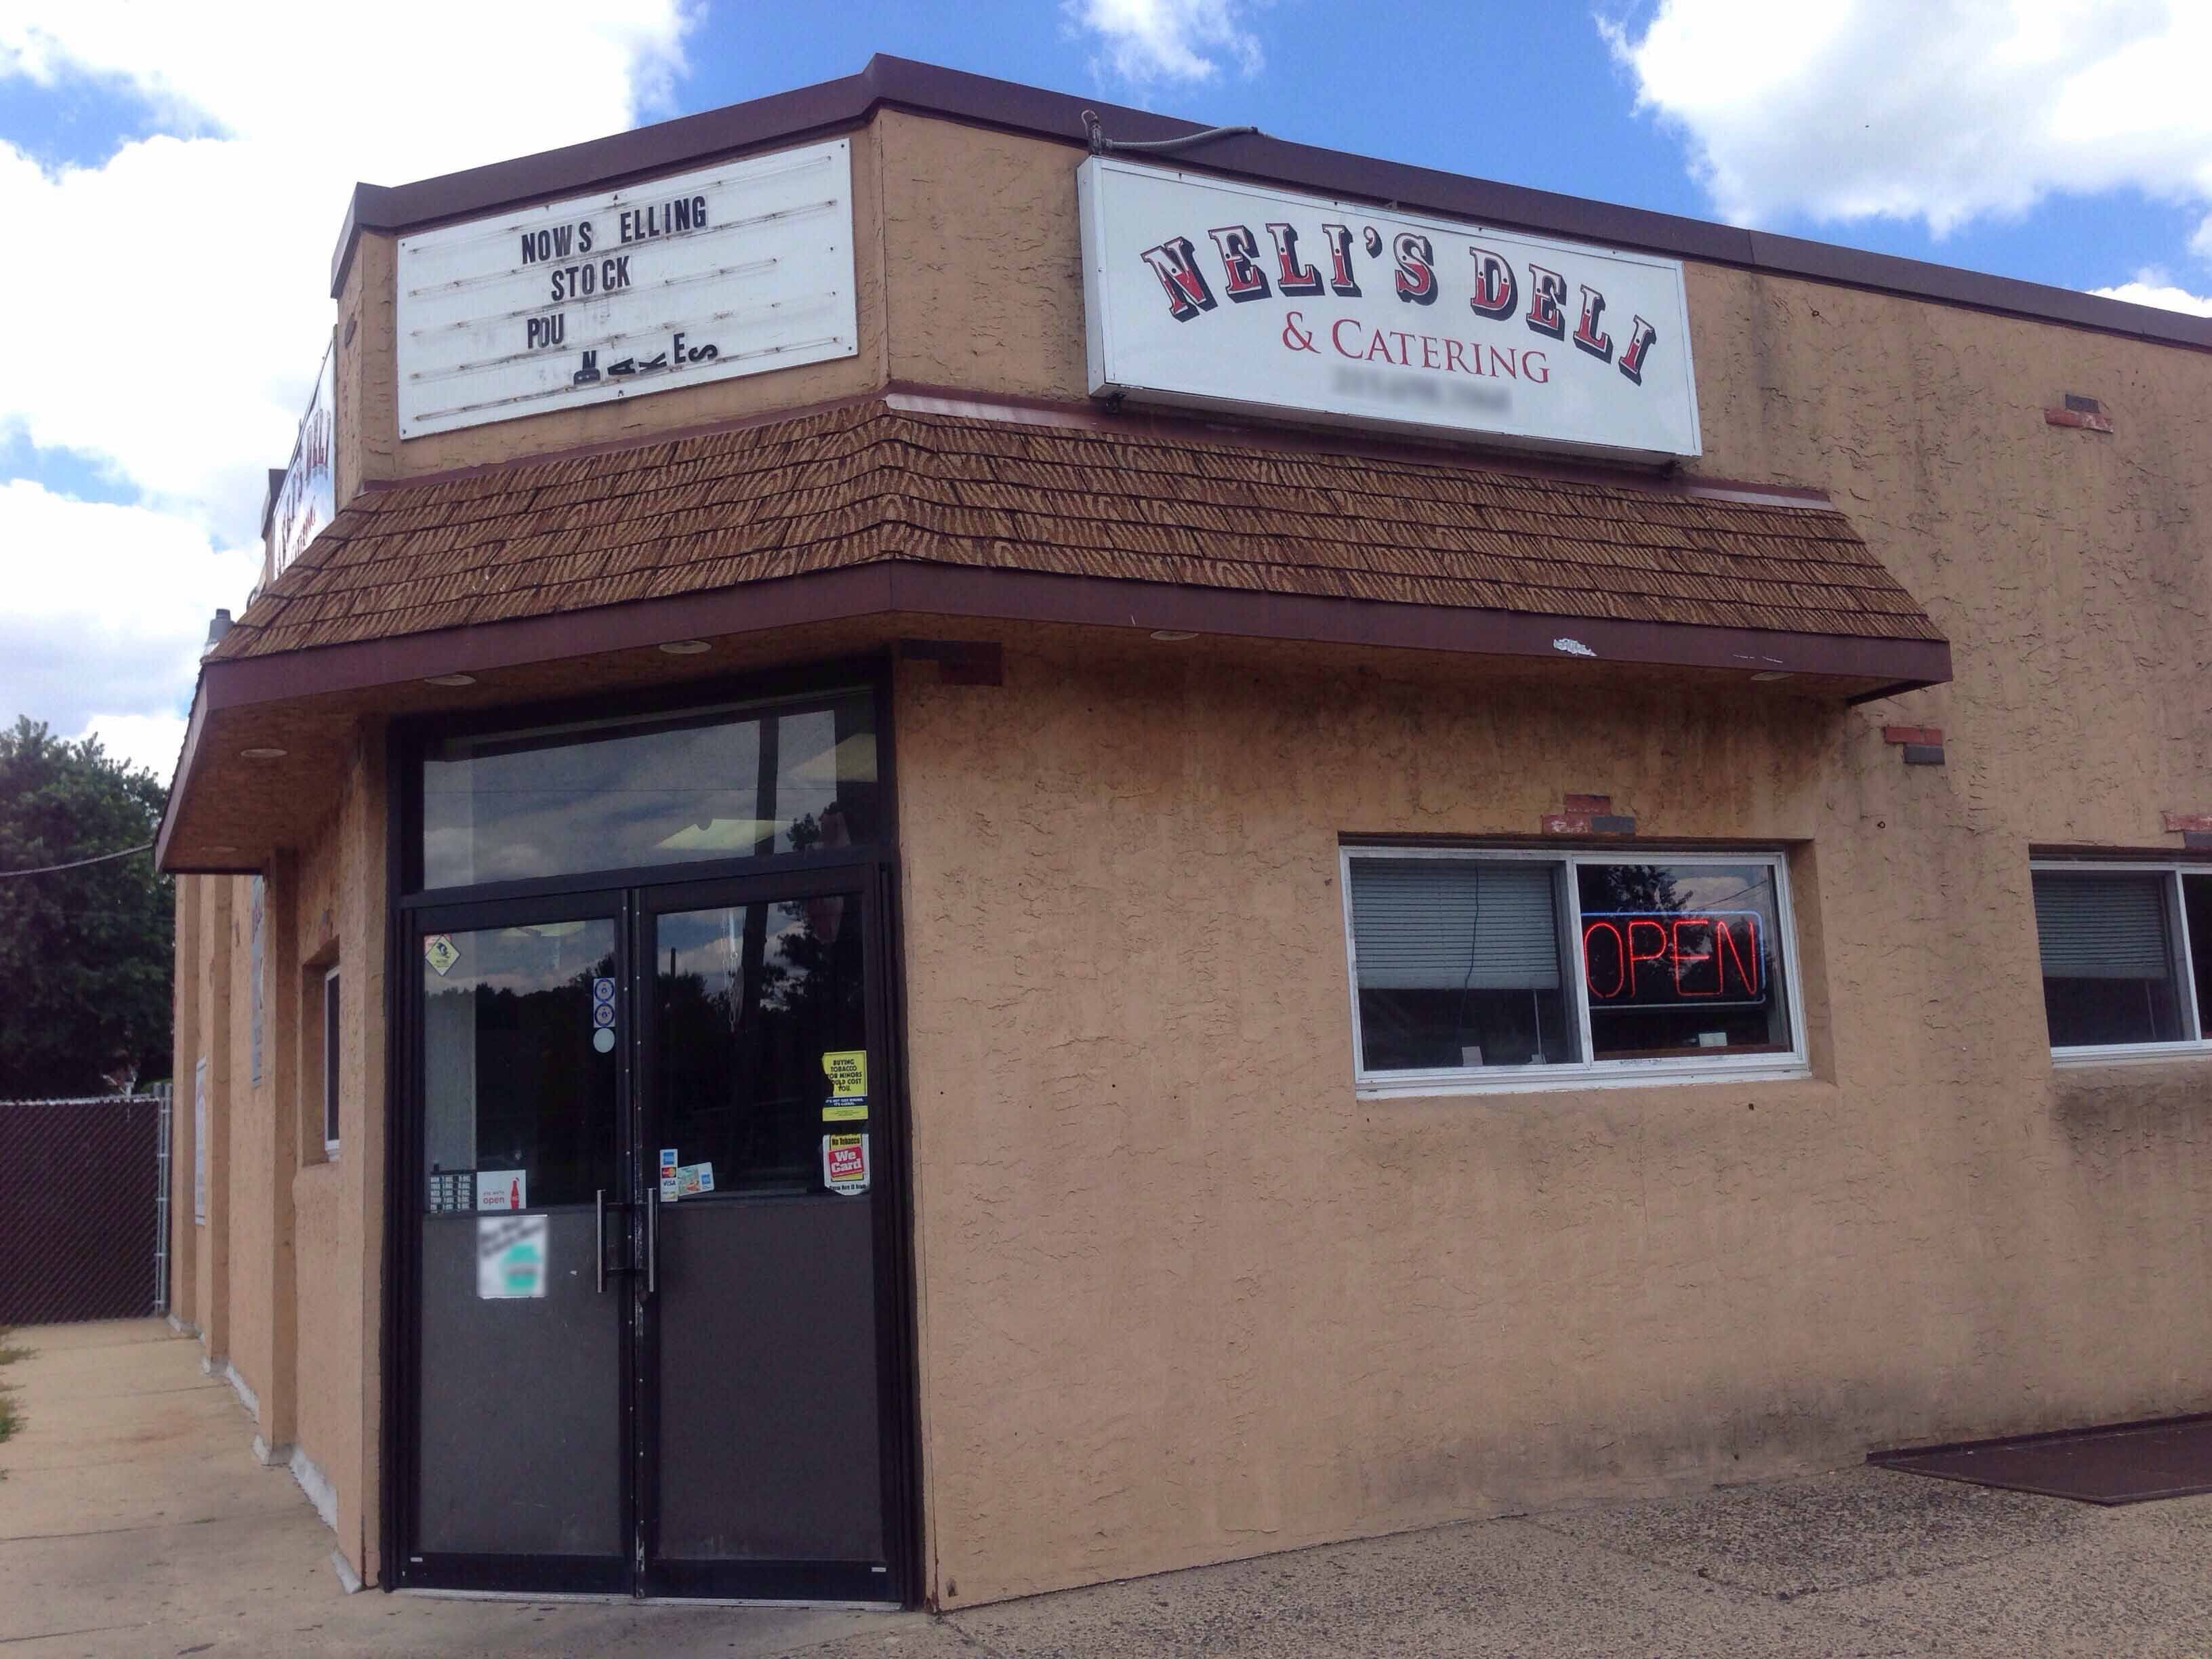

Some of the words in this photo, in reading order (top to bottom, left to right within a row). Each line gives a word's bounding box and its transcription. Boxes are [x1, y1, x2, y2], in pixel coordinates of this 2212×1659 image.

[619, 197, 706, 243] ELLING
[551, 255, 630, 302] STOCK
[1141, 223, 1435, 322] NELI'S
[1470, 246, 1658, 385] DELI
[527, 314, 564, 350] POU
[1282, 311, 1320, 354] &
[1331, 319, 1551, 384] CATERING
[1582, 918, 1758, 998] OPEN
[831, 1158, 862, 1172] Card
[834, 1150, 857, 1162] We
[483, 1197, 505, 1206] open
